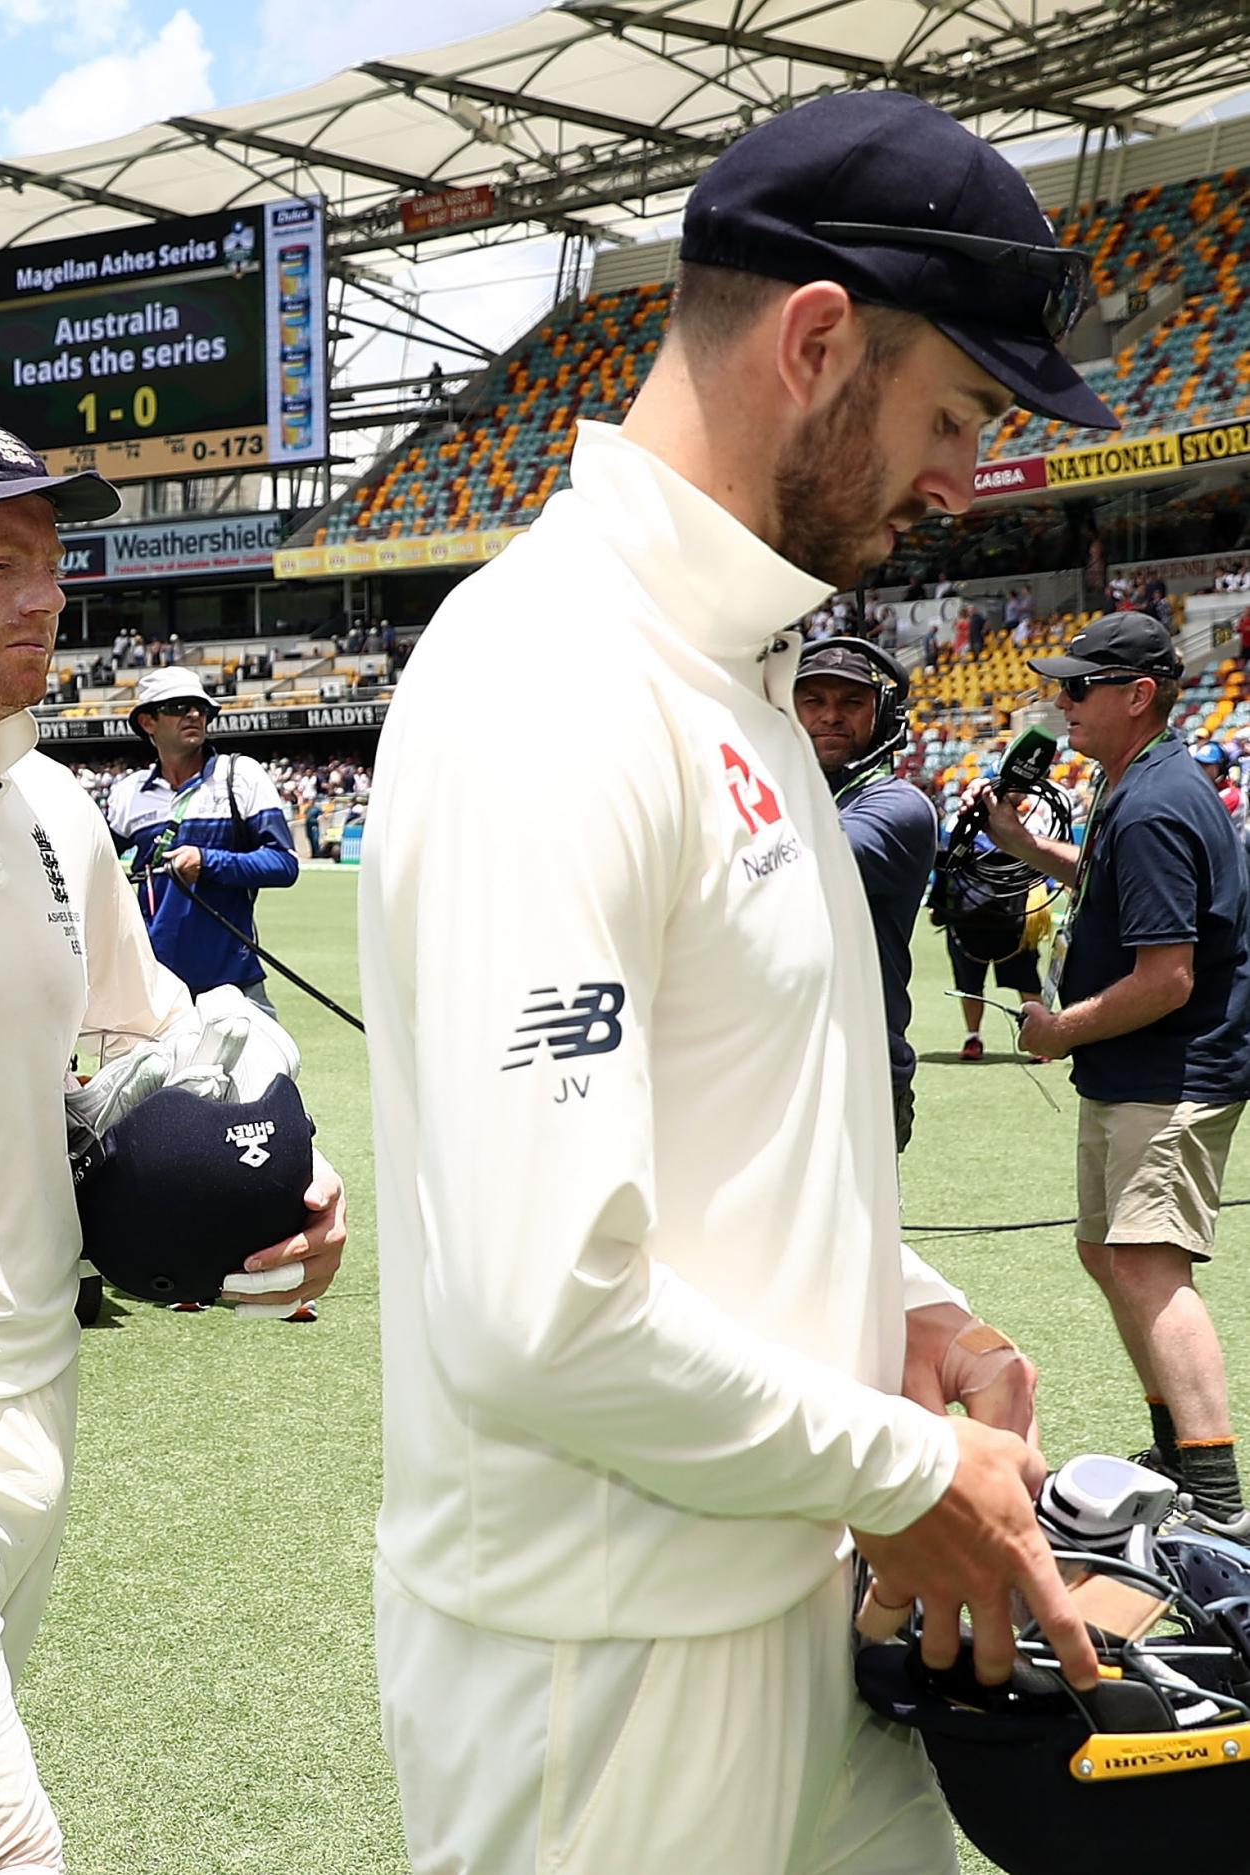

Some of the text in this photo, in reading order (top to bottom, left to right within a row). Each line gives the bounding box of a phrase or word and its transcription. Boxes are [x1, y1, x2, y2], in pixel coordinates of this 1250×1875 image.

[16, 239, 217, 291] Magellan Ashes Series
[54, 302, 179, 346] Australia
[13, 335, 227, 386] leads the series
[78, 393, 97, 433] 1
[133, 385, 158, 427] 0
[193, 435, 264, 460] 0-173
[1048, 441, 1174, 481] NATIONAL
[553, 1074, 591, 1104] JV
[225, 1120, 276, 1143] SHREY
[1105, 1747, 1210, 1769] MASURI
